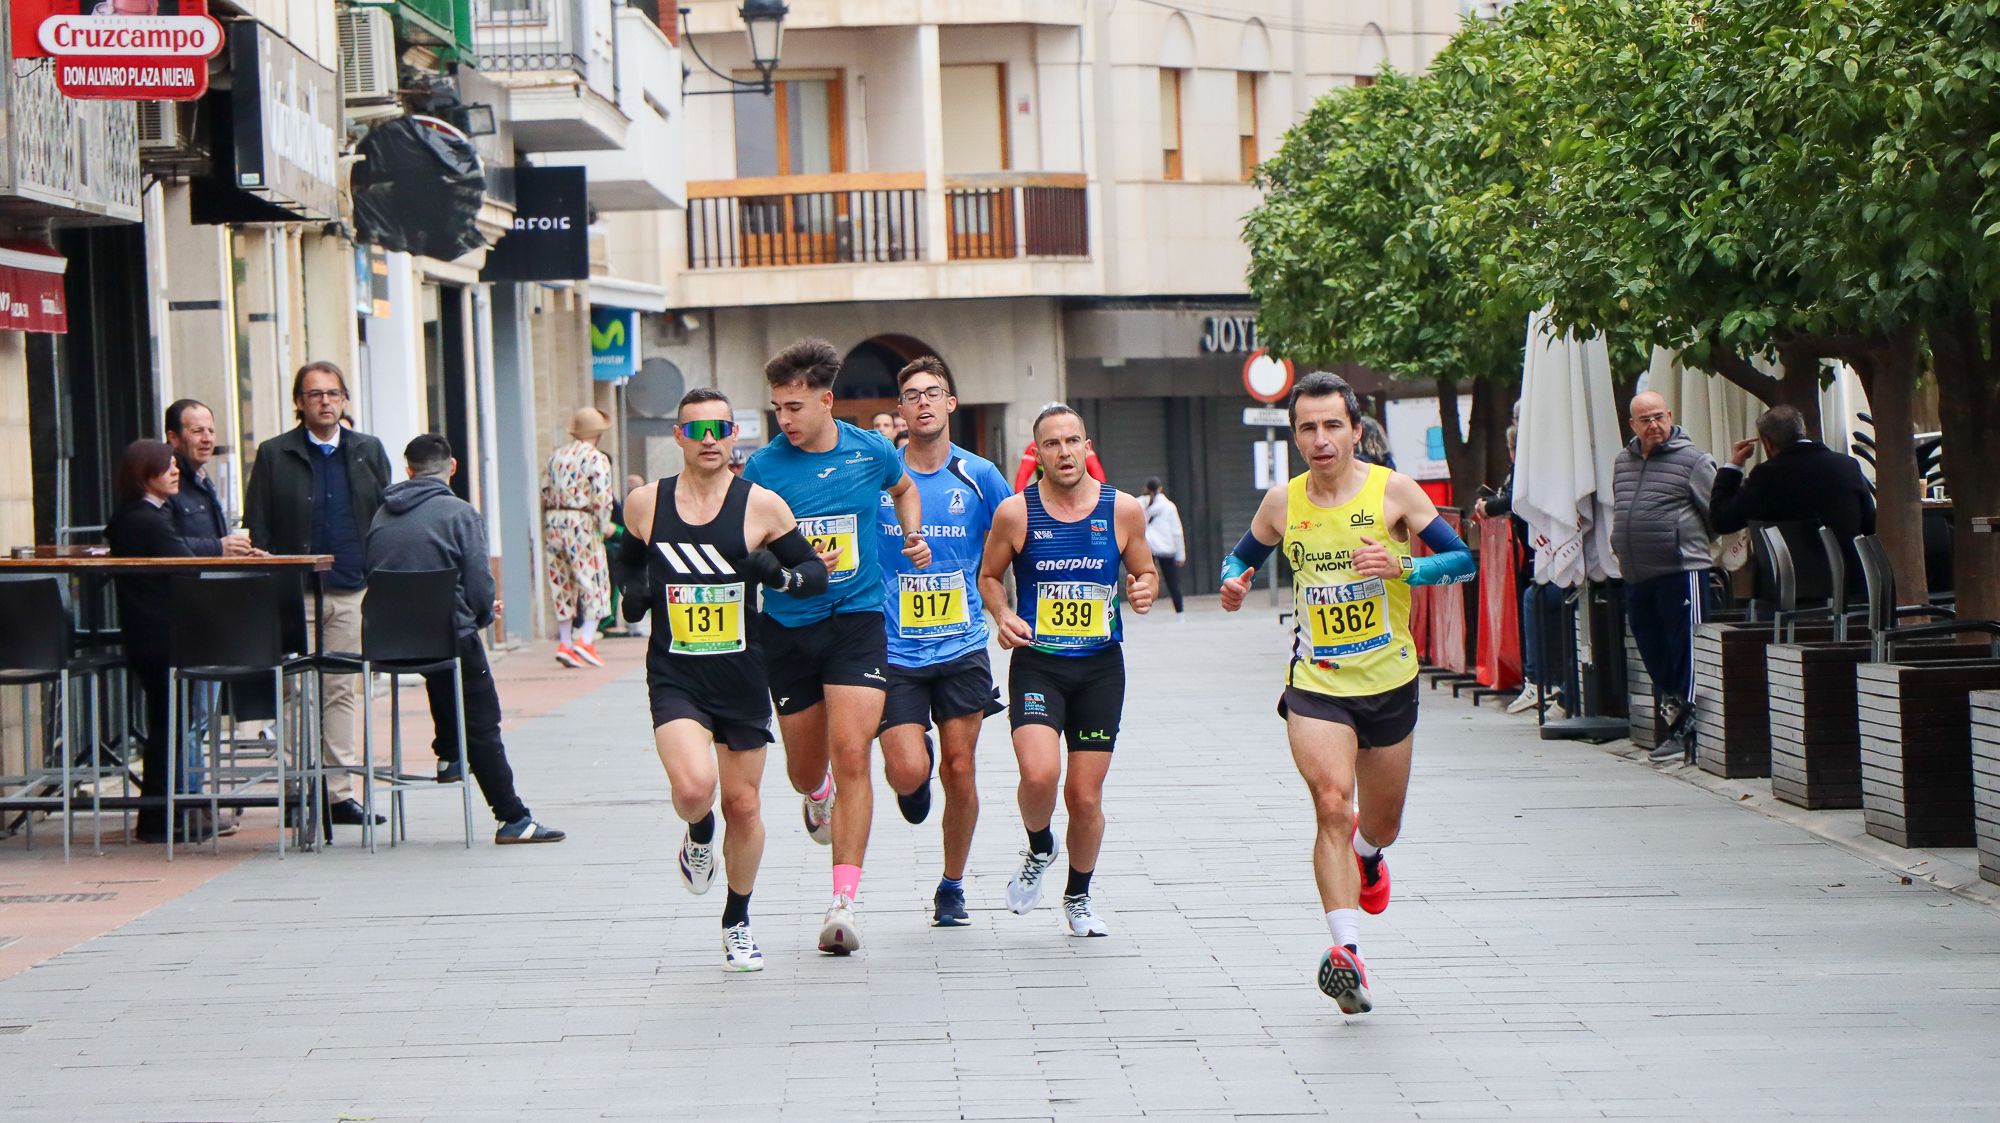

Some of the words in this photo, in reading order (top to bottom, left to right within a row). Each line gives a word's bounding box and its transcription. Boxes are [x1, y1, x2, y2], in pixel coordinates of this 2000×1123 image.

[54, 22, 205, 52] Cruzcampo
[63, 66, 86, 86] DON
[87, 66, 127, 86] ALVARO
[128, 67, 160, 87] PLAZA
[161, 67, 195, 87] NUEVA
[514, 216, 571, 231] RFOIS
[1204, 317, 1258, 352] JOY
[592, 354, 625, 365] ovistar
[1350, 508, 1375, 527] als
[1035, 556, 1105, 571] enerplus
[1305, 551, 1332, 562] CLUB
[1315, 560, 1353, 572] MONT
[913, 592, 951, 618] 917
[1051, 601, 1092, 627] 339
[685, 606, 724, 632] 131
[1317, 600, 1376, 635] 1362
